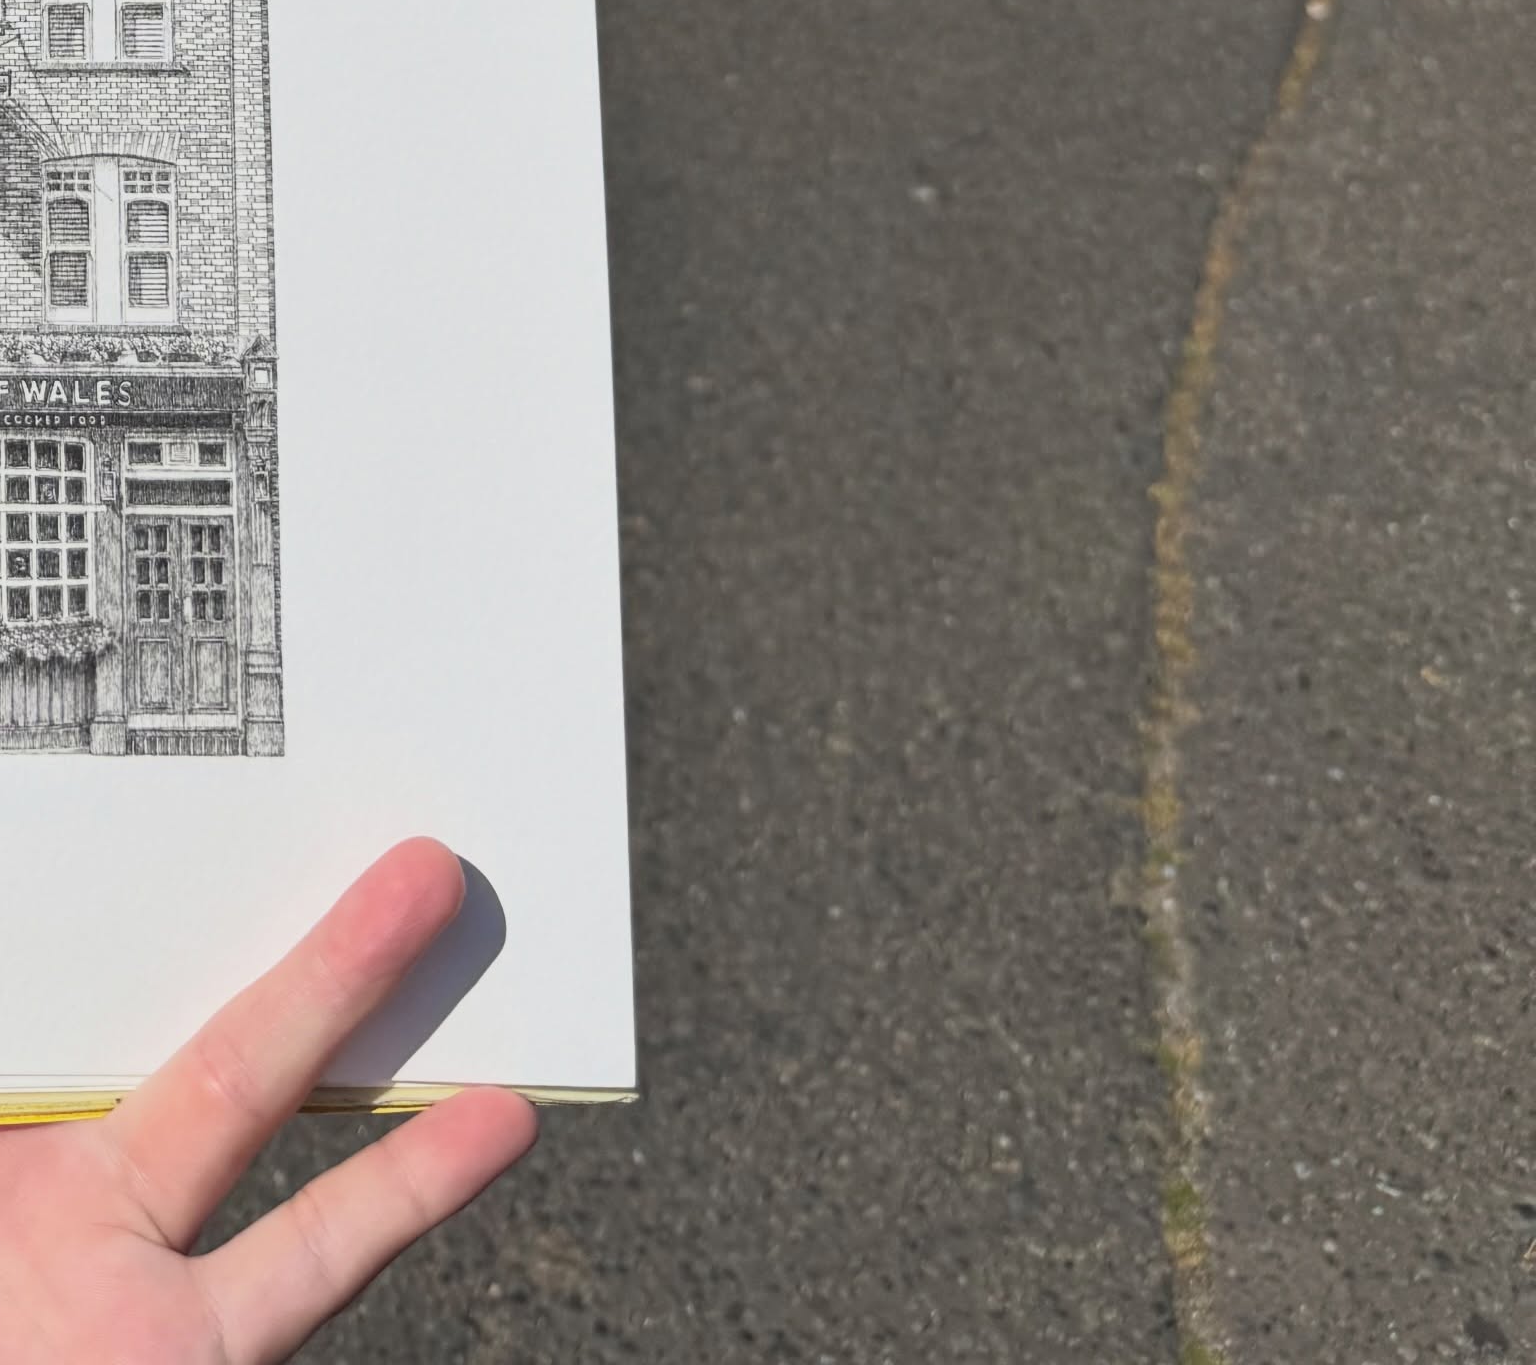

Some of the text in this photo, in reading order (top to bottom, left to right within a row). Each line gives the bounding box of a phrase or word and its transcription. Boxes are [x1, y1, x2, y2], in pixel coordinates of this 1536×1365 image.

[21, 380, 132, 406] WALES
[4, 415, 61, 425] COOKED
[69, 415, 107, 425] FOOD
